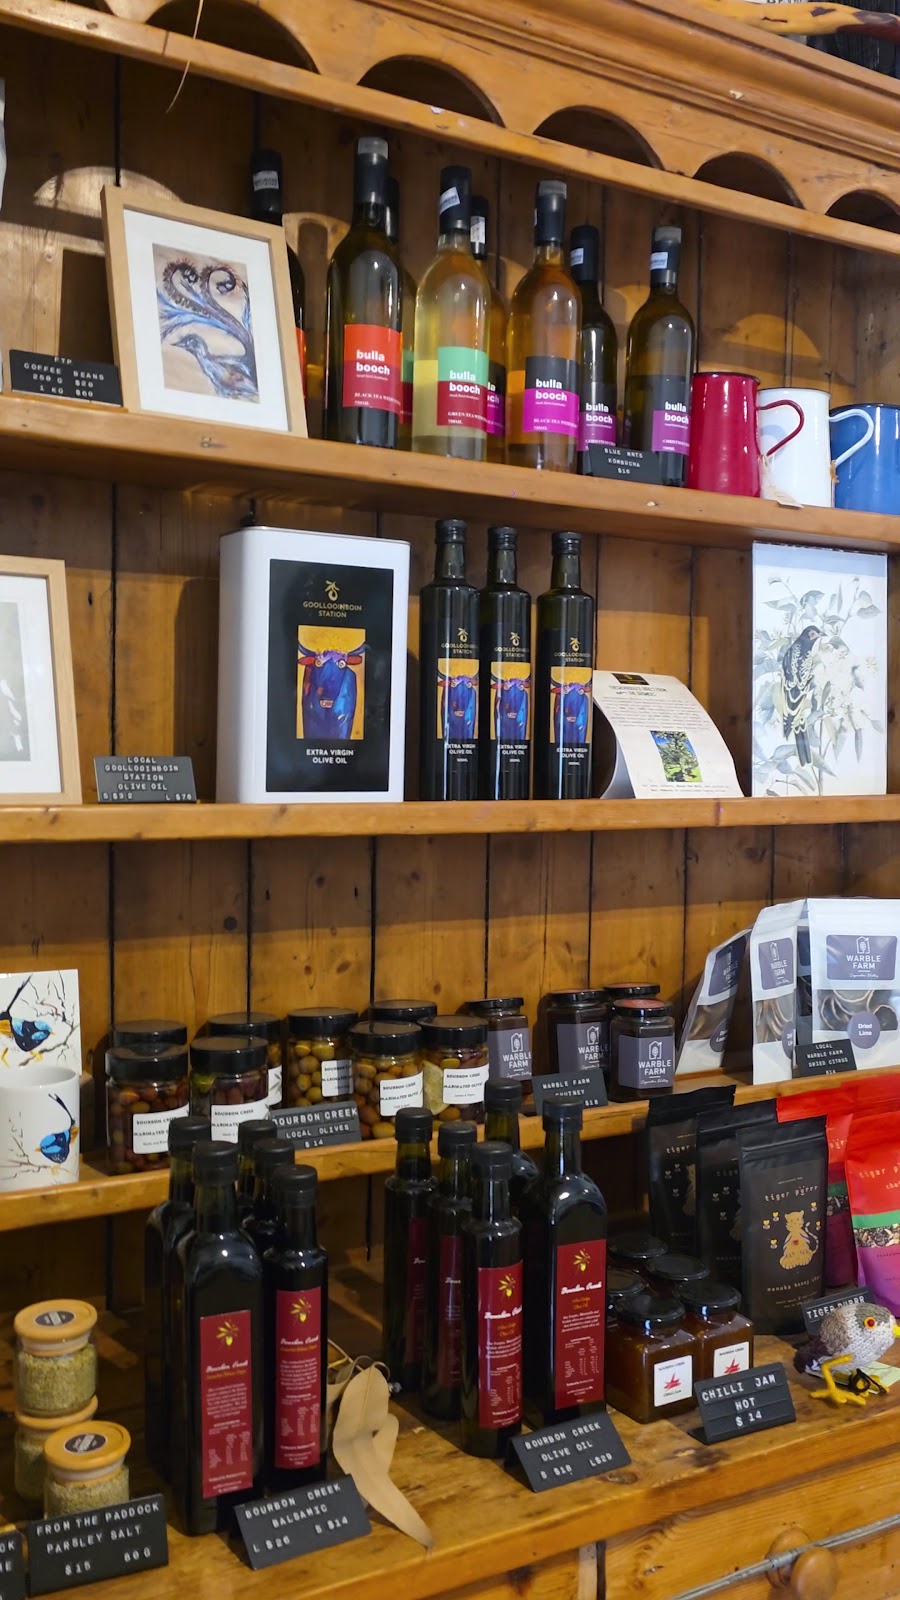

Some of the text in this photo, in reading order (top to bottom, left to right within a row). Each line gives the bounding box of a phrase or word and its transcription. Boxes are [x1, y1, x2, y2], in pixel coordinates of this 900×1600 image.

[54, 356, 72, 364] FTP
[356, 350, 385, 362] bulla
[24, 362, 104, 380] COFFEE BEANS
[356, 362, 390, 376] booch
[450, 370, 476, 382] bulla
[74, 380, 94, 388] $20
[449, 382, 480, 394] booch
[536, 378, 562, 390] bulla
[536, 390, 567, 402] booch
[586, 402, 608, 412] bulla
[665, 401, 686, 412] bulla
[586, 414, 612, 424] booch
[664, 412, 689, 424] booch
[604, 448, 622, 456] BLUE
[608, 458, 640, 468] KOMBUCHA
[318, 610, 346, 618] STATION
[105, 764, 178, 772] GOOLLOOINBOIN
[578, 1044, 608, 1054] WARBLE
[502, 1052, 532, 1062] WARBLE
[584, 1052, 604, 1061] FARM
[828, 1057, 848, 1065] CITRUS
[508, 1060, 528, 1069] FARM
[638, 1060, 672, 1068] WARBLE
[542, 1078, 590, 1089] WARBLE FARM
[324, 1108, 358, 1119] CREEK
[286, 1124, 349, 1139] LOCAL OLIVES
[666, 1145, 690, 1154] tiger
[859, 1168, 885, 1178] tiger
[765, 1192, 790, 1201] tiger
[806, 1305, 835, 1319] TIGER
[702, 1374, 775, 1402] CHILLI JAM
[735, 1398, 756, 1411] HOT
[525, 1422, 601, 1450] BOURBON CREEK
[541, 1440, 593, 1461] OLIVE OIL
[245, 1483, 341, 1519] BOURBON CREEK
[37, 1502, 159, 1536] FROM THE PADDOCK
[272, 1504, 327, 1528] BALSAMIC
[47, 1525, 141, 1554] PARSLEY SALT
[253, 1544, 260, 1553] L
[327, 1516, 348, 1530] $14
